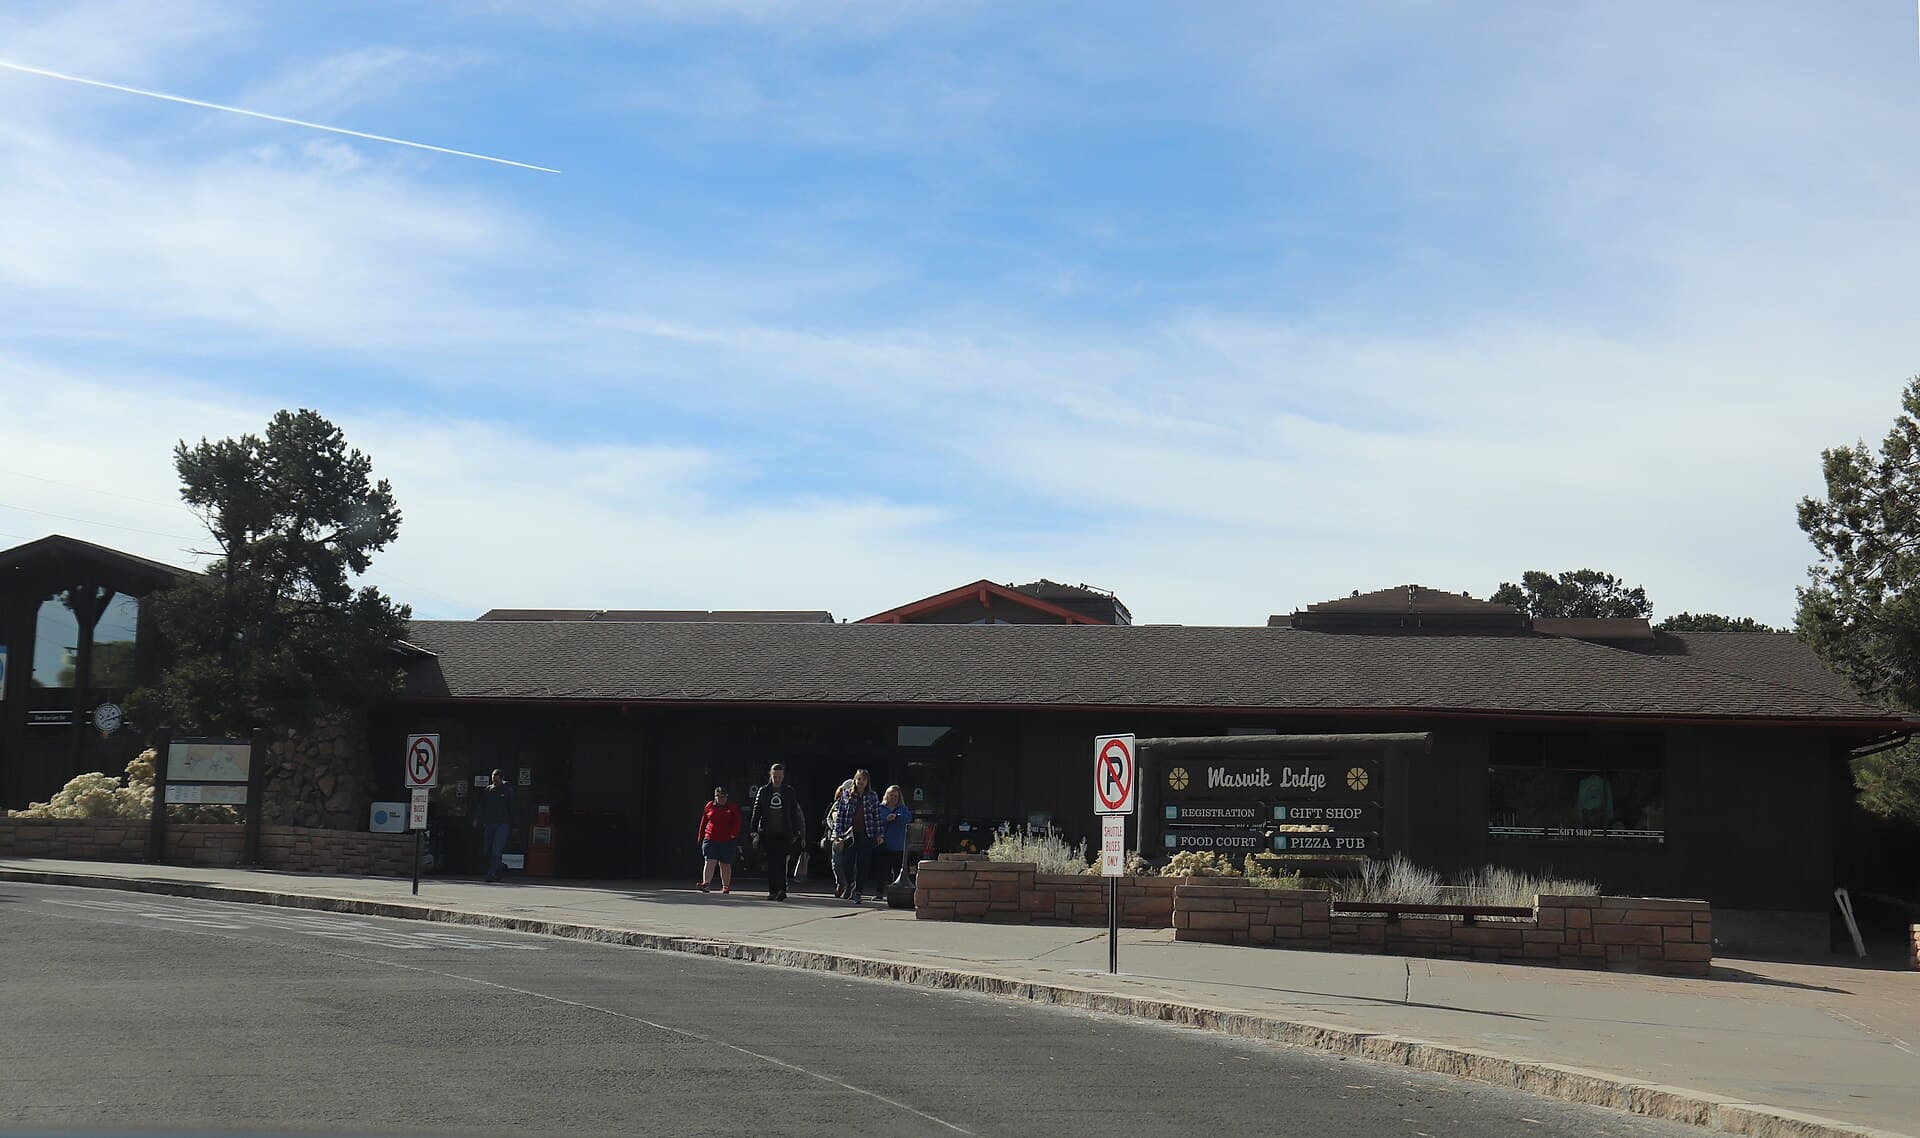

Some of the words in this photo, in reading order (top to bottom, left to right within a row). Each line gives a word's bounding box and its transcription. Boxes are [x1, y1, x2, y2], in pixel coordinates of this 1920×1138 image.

[1107, 757, 1123, 795] P
[1207, 766, 1273, 788] Maswik
[1280, 767, 1326, 792] Lodge
[1181, 808, 1255, 818] REGISTRATION
[1290, 808, 1323, 819] GIFT
[1326, 808, 1362, 819] SHOP
[1104, 826, 1123, 837] SHUTTLE
[1105, 841, 1120, 852] BUSES
[1180, 837, 1213, 847] FOOD
[1216, 837, 1257, 847] COURT
[1290, 837, 1331, 848] PIZZA
[1336, 837, 1365, 848] PUB
[1107, 855, 1119, 867] ONLY
[296, 930, 549, 951] BUS
